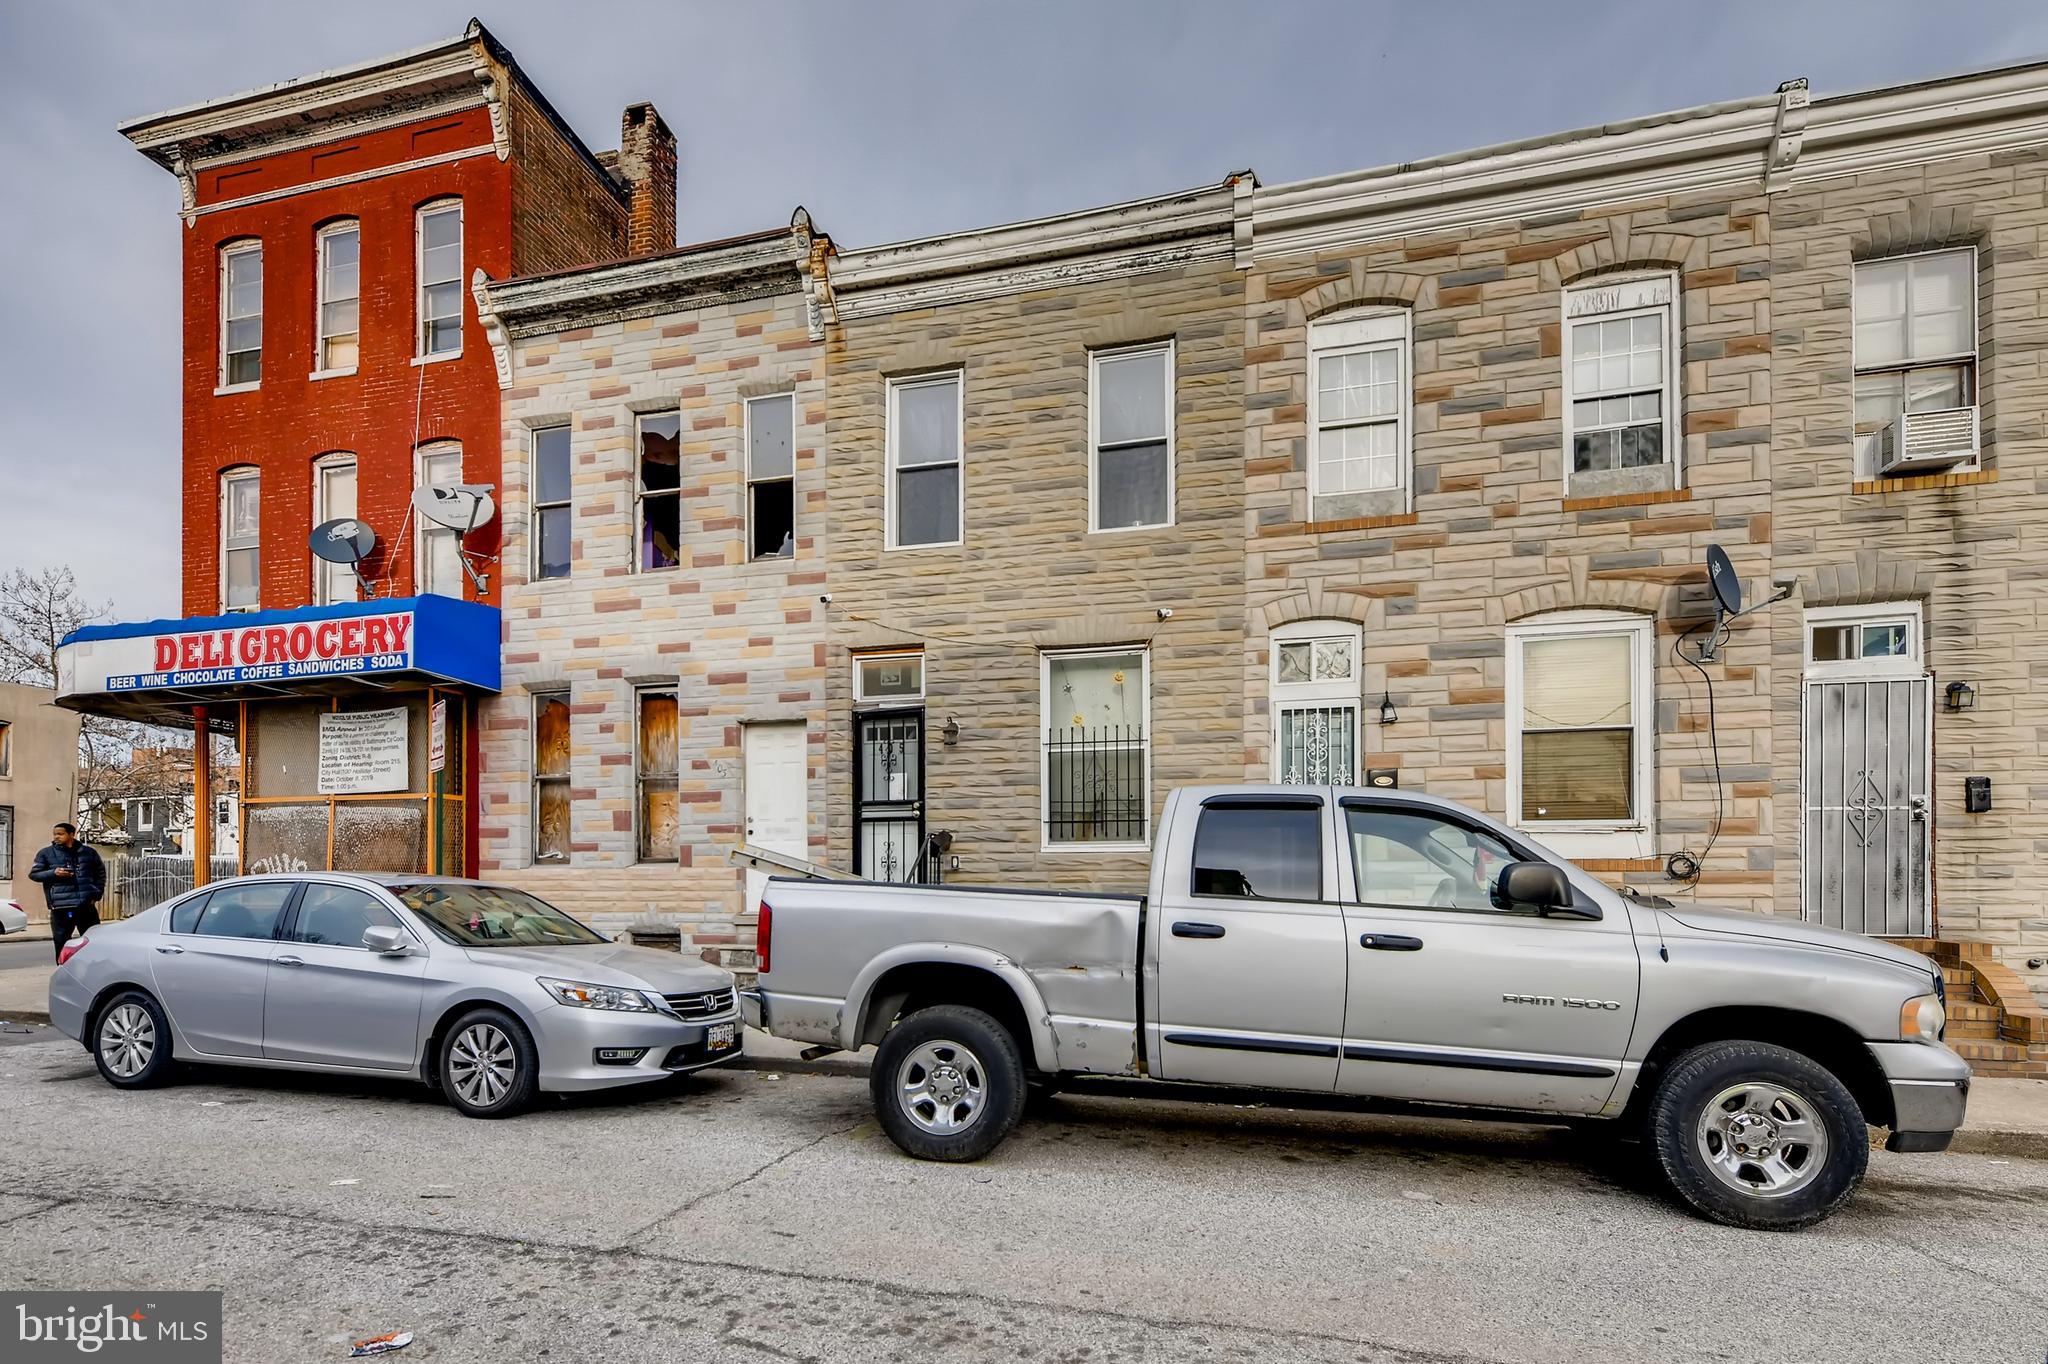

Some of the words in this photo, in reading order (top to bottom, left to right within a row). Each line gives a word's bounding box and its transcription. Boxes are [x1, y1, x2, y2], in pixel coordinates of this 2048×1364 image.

[154, 631, 235, 673] DELI
[239, 613, 413, 666] GROCERY
[109, 676, 136, 689] BEER
[141, 674, 168, 687] WINE
[173, 668, 235, 685] CHOCOLATE
[241, 664, 283, 680] COFFEE
[288, 658, 365, 675] SANDWICHES
[371, 655, 403, 669] SODA
[1502, 993, 1555, 1006] RAM
[1561, 997, 1621, 1011] 1500
